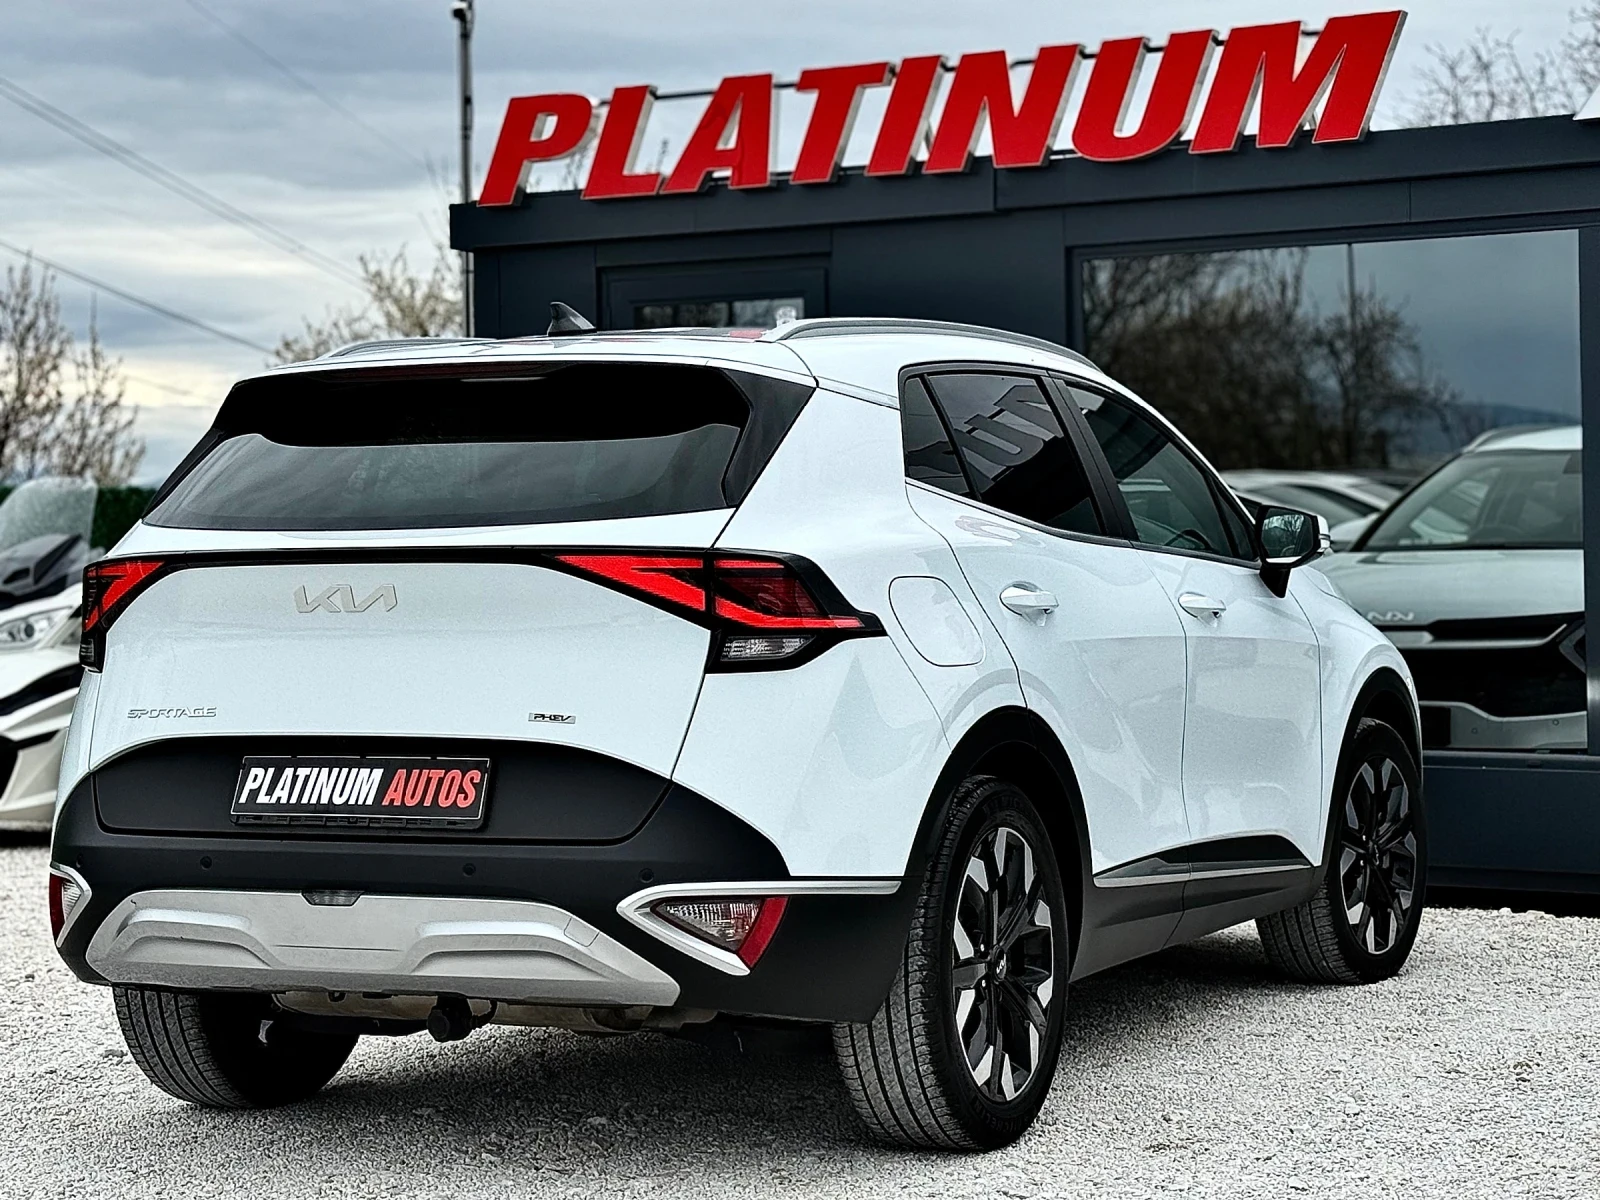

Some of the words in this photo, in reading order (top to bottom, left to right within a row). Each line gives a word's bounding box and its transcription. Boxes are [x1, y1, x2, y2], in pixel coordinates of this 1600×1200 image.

[476, 10, 1405, 207] PLATINUM
[293, 584, 397, 613] KIA
[127, 707, 217, 719] SPORTAGE
[531, 712, 573, 722] PHEV
[238, 767, 384, 806] PLATINUM
[381, 768, 481, 808] AUTOS
